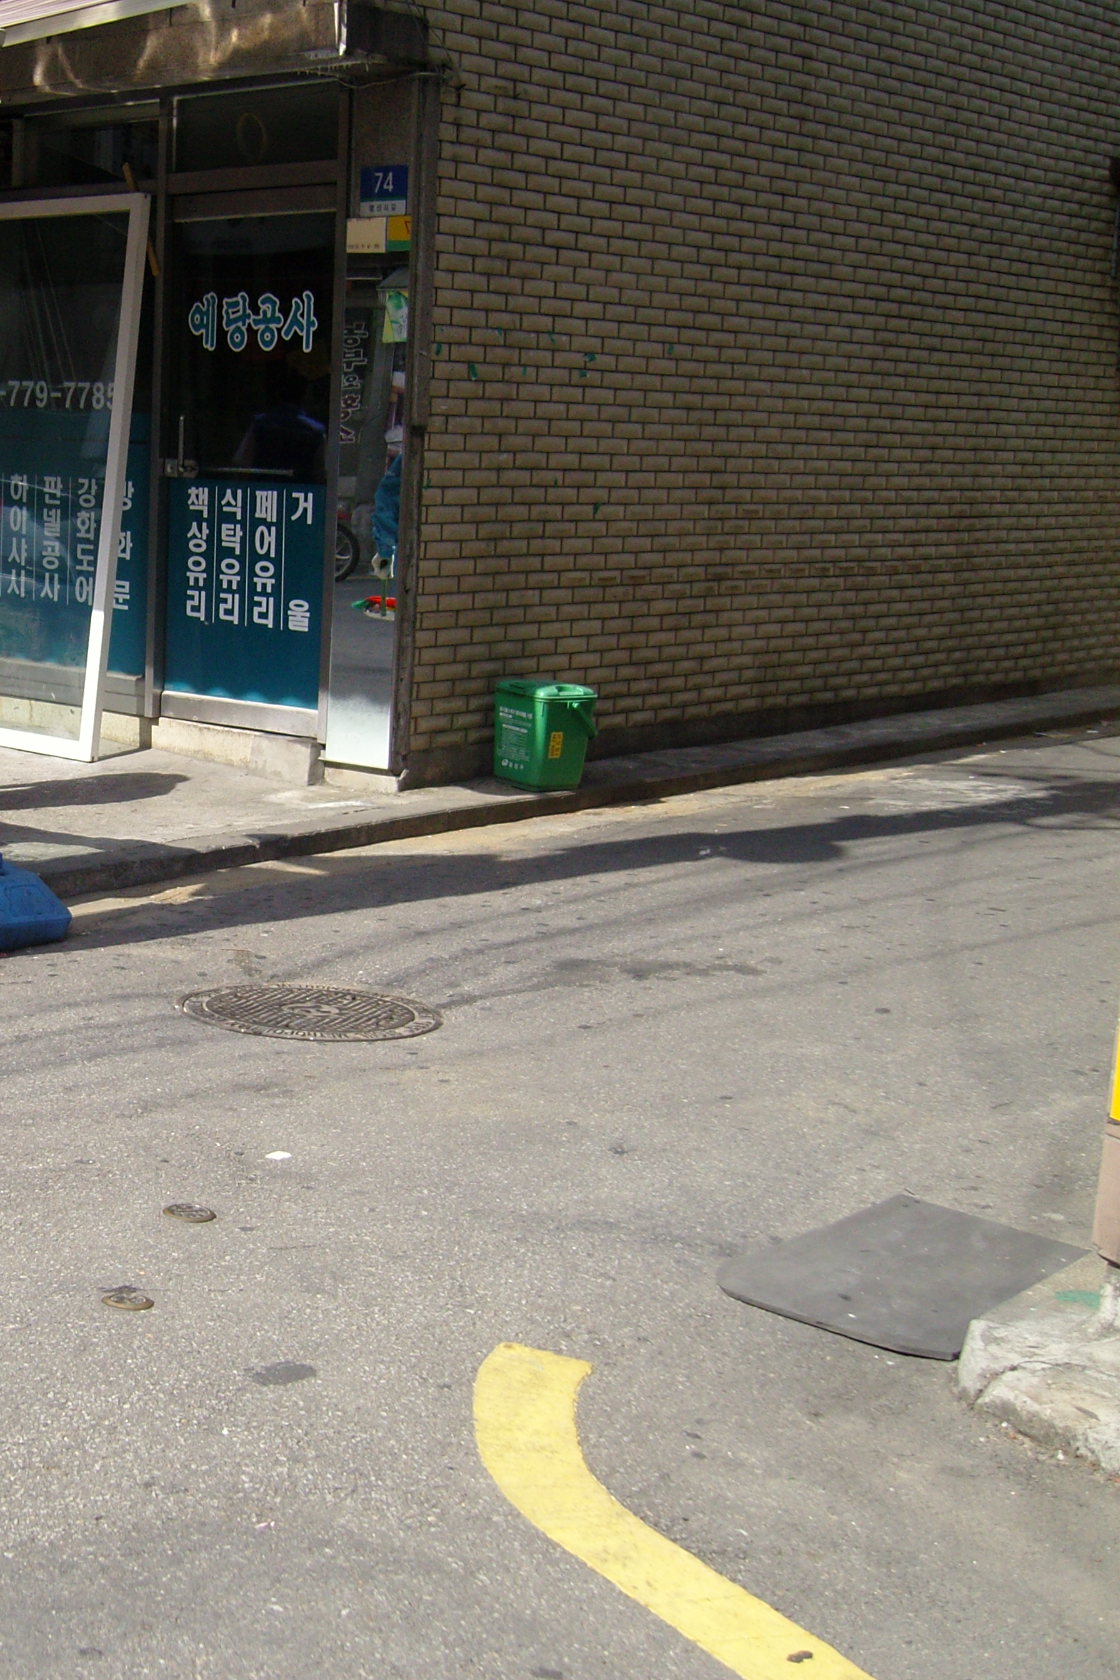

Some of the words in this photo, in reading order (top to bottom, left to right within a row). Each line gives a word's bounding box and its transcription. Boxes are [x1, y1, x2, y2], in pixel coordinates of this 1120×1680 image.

[374, 171, 394, 193] 74
[188, 290, 318, 353] 예당공사
[7, 474, 29, 598] 하이샤시
[40, 475, 63, 602] 판넬공사
[75, 478, 98, 607] 강화도어
[186, 486, 209, 622] 책상유리
[219, 488, 243, 625] 식탁유리
[253, 490, 278, 629] 페어유리
[287, 491, 314, 632] 거울
